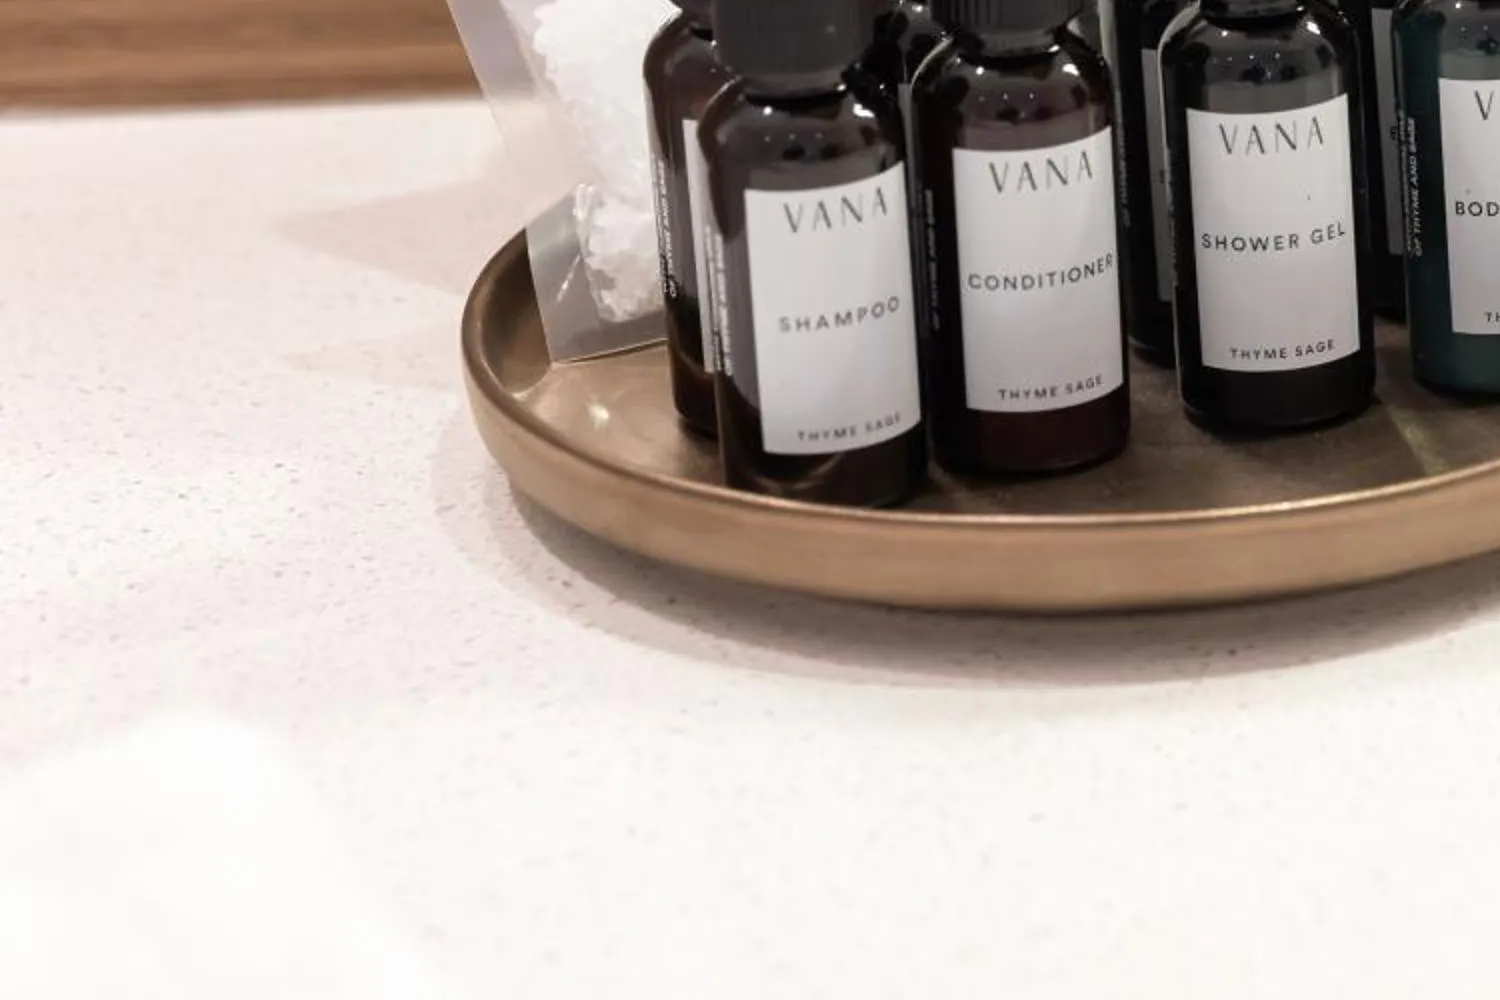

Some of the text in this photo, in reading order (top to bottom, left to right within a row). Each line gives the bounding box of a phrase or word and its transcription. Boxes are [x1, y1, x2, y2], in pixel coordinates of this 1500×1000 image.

[1219, 115, 1325, 156] VANA
[988, 150, 1094, 194] VANA
[783, 186, 889, 234] VANA
[1201, 220, 1346, 252] SHOWER GEL
[967, 252, 1115, 291] CONDITIONER
[778, 295, 900, 334] SHAMPOO
[1230, 339, 1336, 361] THYME SAGE
[997, 376, 1104, 402] THYME SAGE
[797, 413, 902, 443] THYME SAGE
